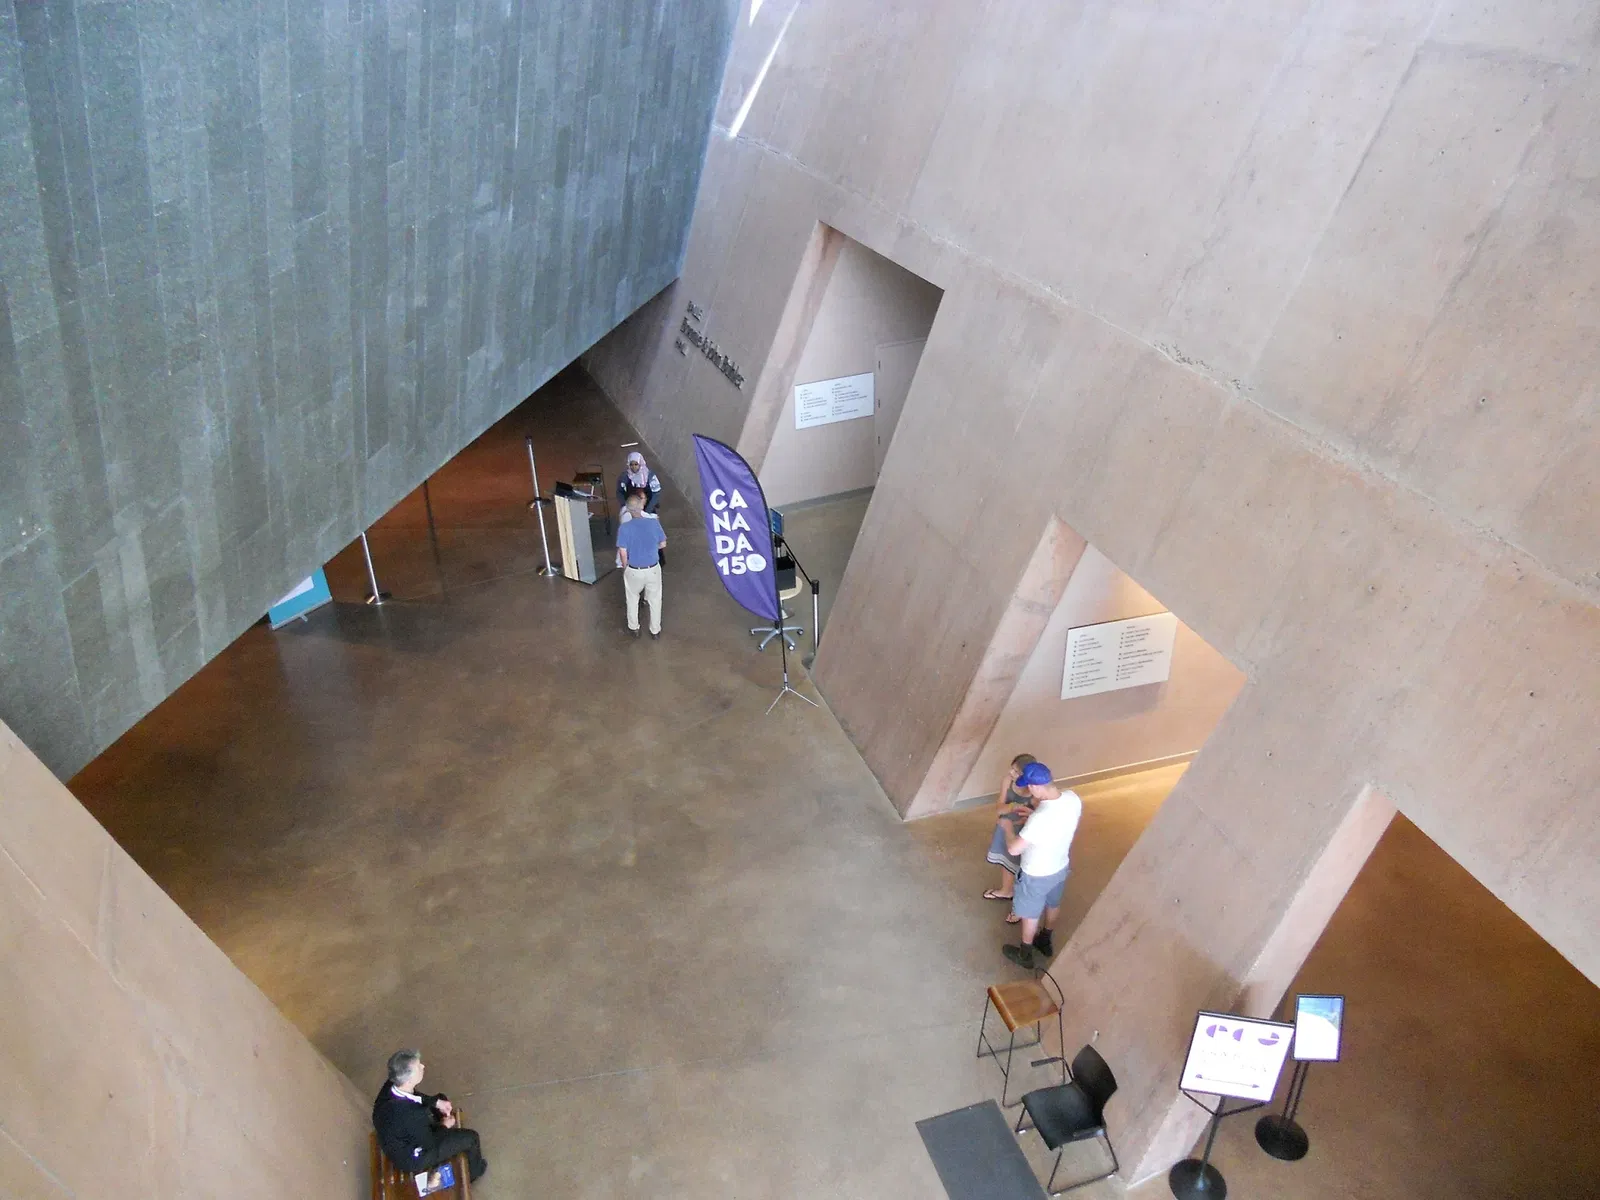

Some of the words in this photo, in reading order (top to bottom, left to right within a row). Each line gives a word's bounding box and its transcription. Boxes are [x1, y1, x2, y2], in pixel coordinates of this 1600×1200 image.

[709, 488, 748, 511] CA
[712, 511, 751, 533] NA
[715, 533, 754, 554] DA
[717, 553, 767, 576] 150
